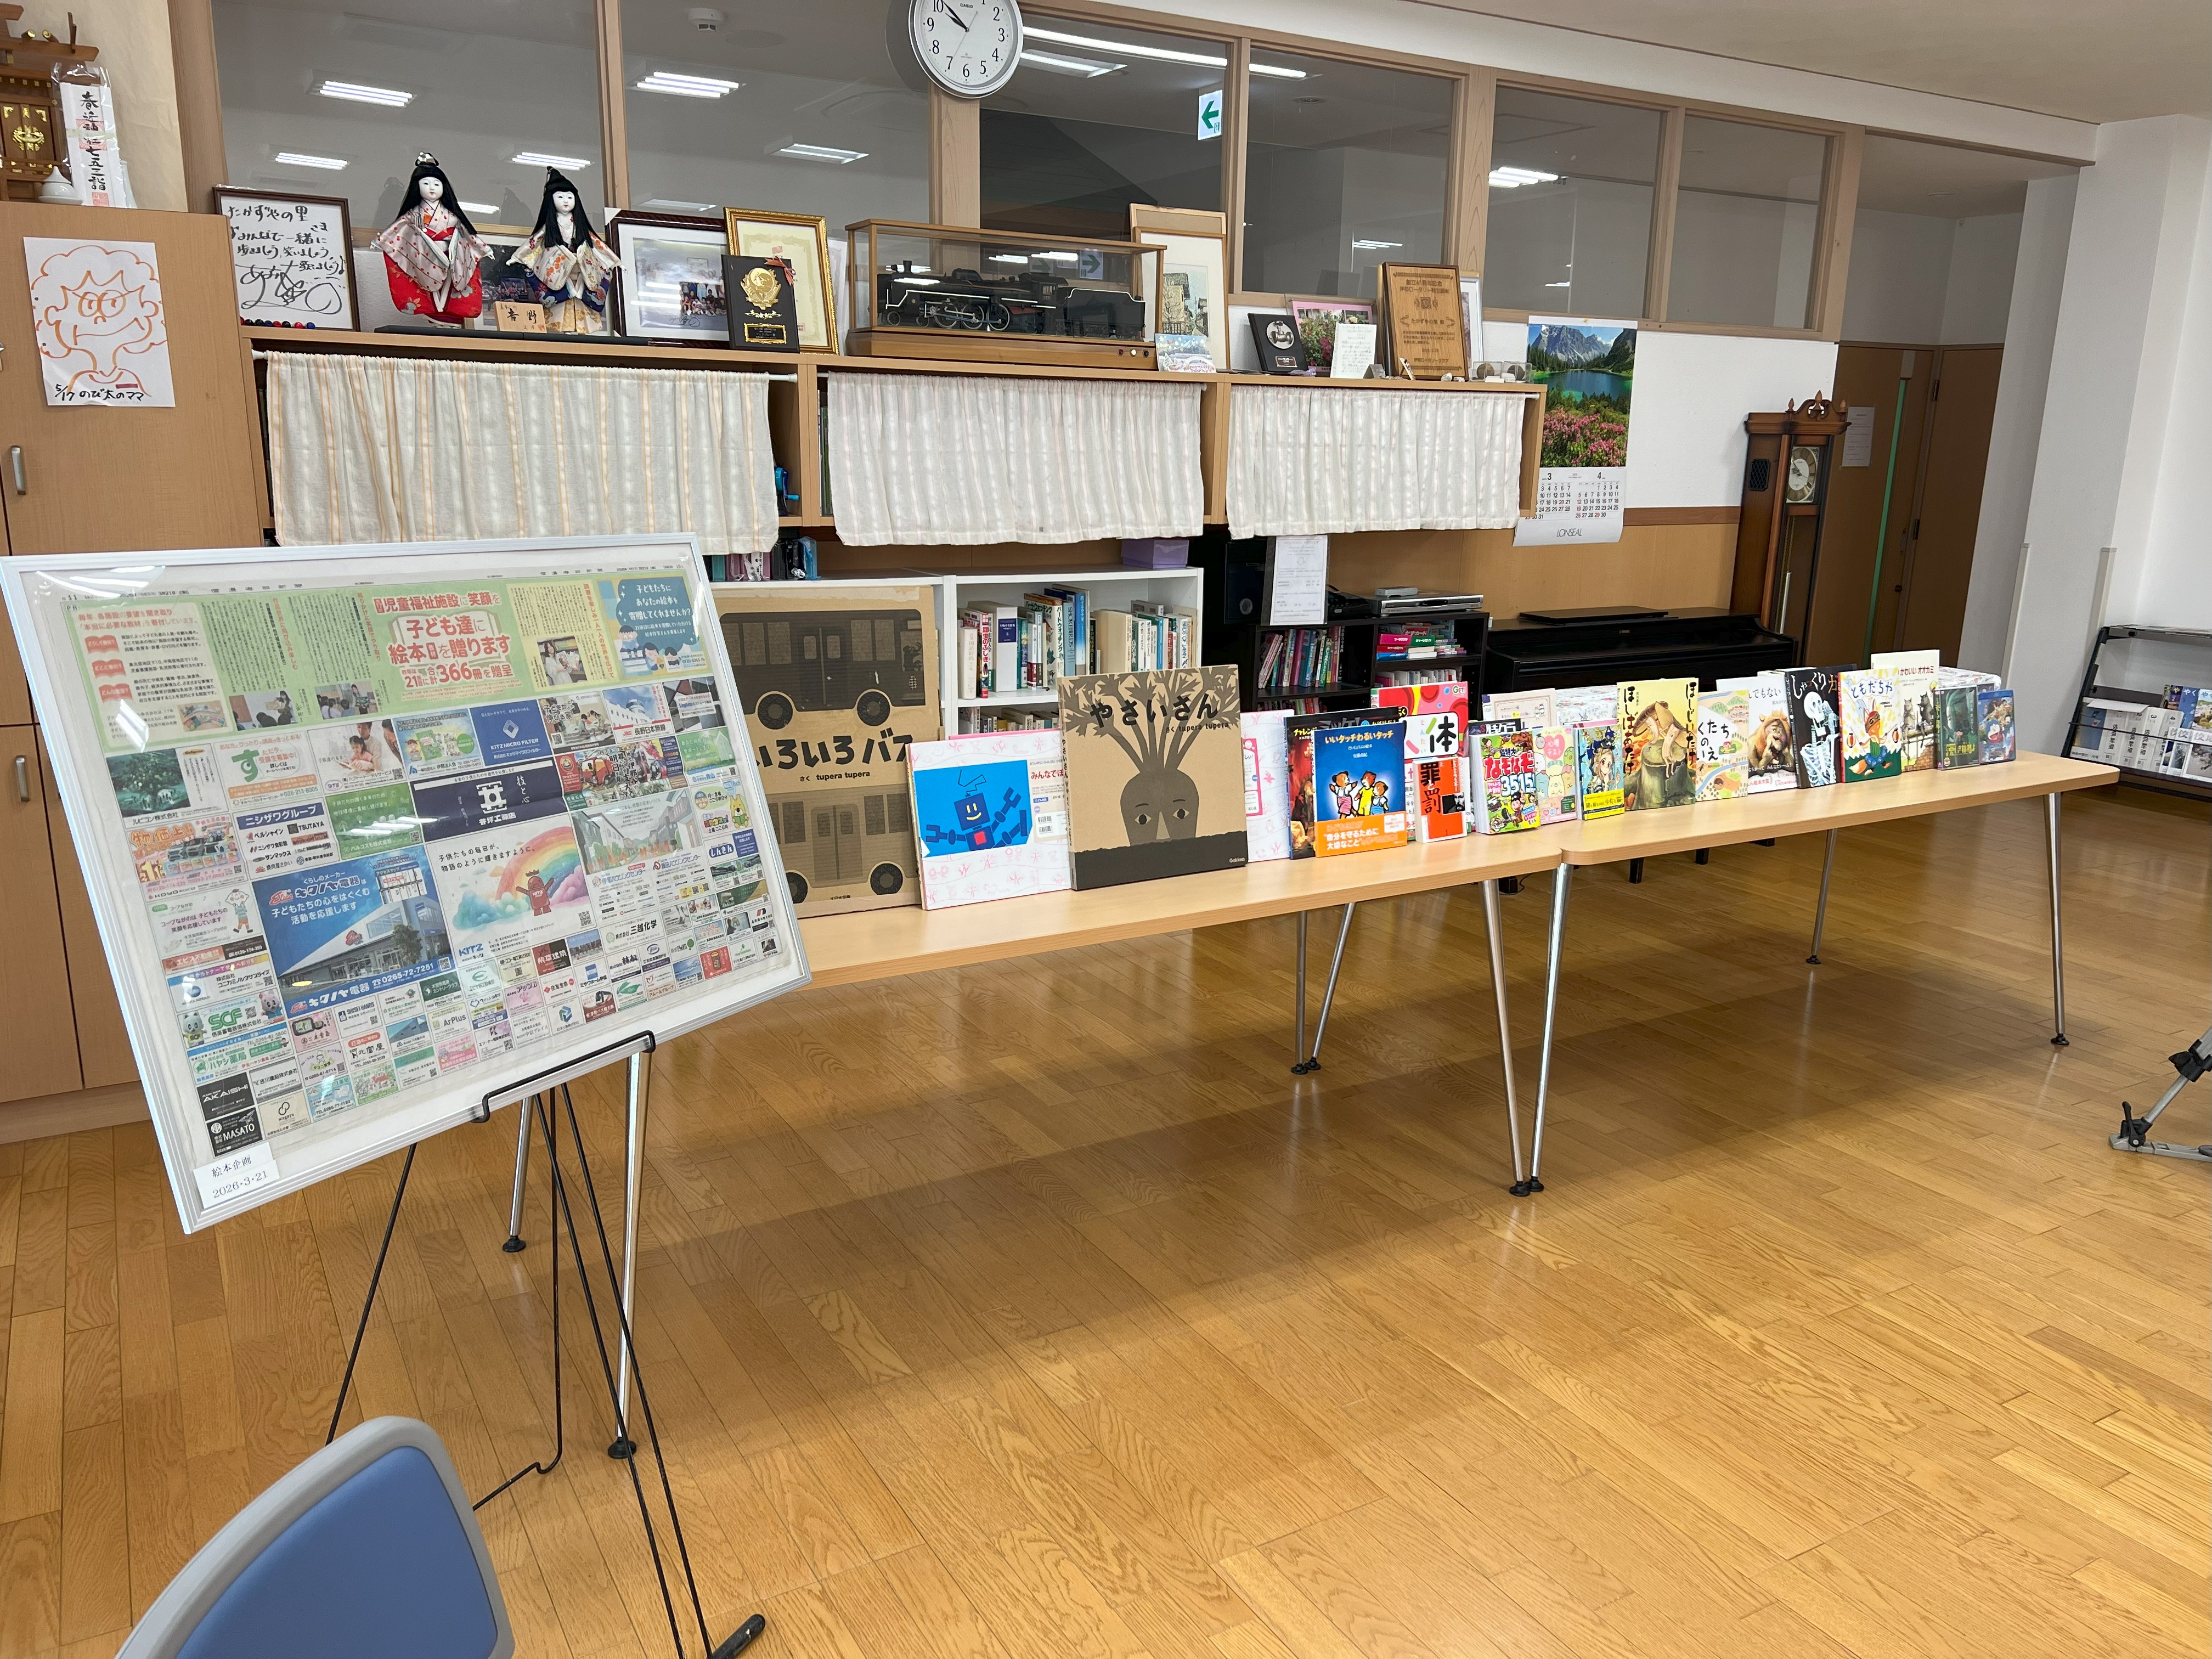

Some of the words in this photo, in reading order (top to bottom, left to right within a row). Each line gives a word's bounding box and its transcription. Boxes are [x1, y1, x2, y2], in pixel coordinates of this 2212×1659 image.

[933, 0, 944, 13] 10
[993, 7, 1000, 21] 2
[927, 17, 934, 32] 9
[997, 27, 1005, 42] 3
[932, 40, 940, 54] 8
[946, 55, 953, 70] 7
[991, 48, 999, 62] 4
[963, 63, 970, 77] 6
[979, 60, 986, 74] 5
[55, 383, 75, 402] 5/17
[79, 388, 144, 402] のび太のママ
[1557, 528, 1582, 537] LONSEAL
[635, 583, 672, 594] 子どもたちに
[382, 590, 502, 612] 児童福祉施設に笑顔を
[634, 595, 679, 607] あなたの絵本を
[627, 607, 692, 621] 寄贈してくれませんか?
[403, 613, 487, 640] 子ども達に
[1748, 687, 1781, 699] でもない
[1850, 680, 1893, 698] ともだちや
[1090, 692, 1219, 729] やさいさん
[633, 723, 667, 736] 長野日本無線
[1178, 723, 1202, 733] tupera
[1204, 721, 1229, 731] tupera
[1430, 715, 1457, 753] 体
[521, 737, 539, 746] FILTER
[1324, 730, 1394, 744] いいタッチわるいタッチ
[1547, 748, 1562, 756] テスト
[1483, 750, 1536, 780] なぞなぞ
[816, 772, 843, 782] tupera
[844, 770, 870, 780] tupera
[514, 774, 531, 804] 技と心
[1420, 761, 1441, 814] 罪と罰
[131, 811, 179, 825] ルビコン株式会社
[244, 804, 318, 827] ニシザワグループ
[298, 820, 325, 831] TSUTAYA
[253, 827, 285, 840] ベルシャイン
[264, 849, 292, 861] サンマックス
[437, 842, 500, 863] 子供たちの毎日が、
[709, 844, 733, 857] しんきん
[440, 844, 536, 873] 物語のように輝きますように。
[302, 869, 347, 885] くらしのメーカー
[292, 874, 361, 900] キクノヤ電器
[270, 886, 371, 919] 子どもたちの心をはぐくむ
[198, 906, 229, 919] 子どもたちの
[289, 900, 358, 926] 活動を応援します
[457, 942, 484, 957] KITZ
[307, 981, 371, 1009] キクノヤ電器
[380, 962, 435, 984] 0265-72-7251
[550, 980, 568, 992] 住友生命
[206, 1007, 245, 1032] SCF
[442, 1012, 467, 1027] ArPlus
[208, 1049, 248, 1071] ハヤシ薬局
[201, 1082, 249, 1104] AKAISHI
[222, 1122, 256, 1142] MASATO
[212, 1154, 252, 1178] 絵本企画
[212, 1171, 268, 1199] 2026・3・21
